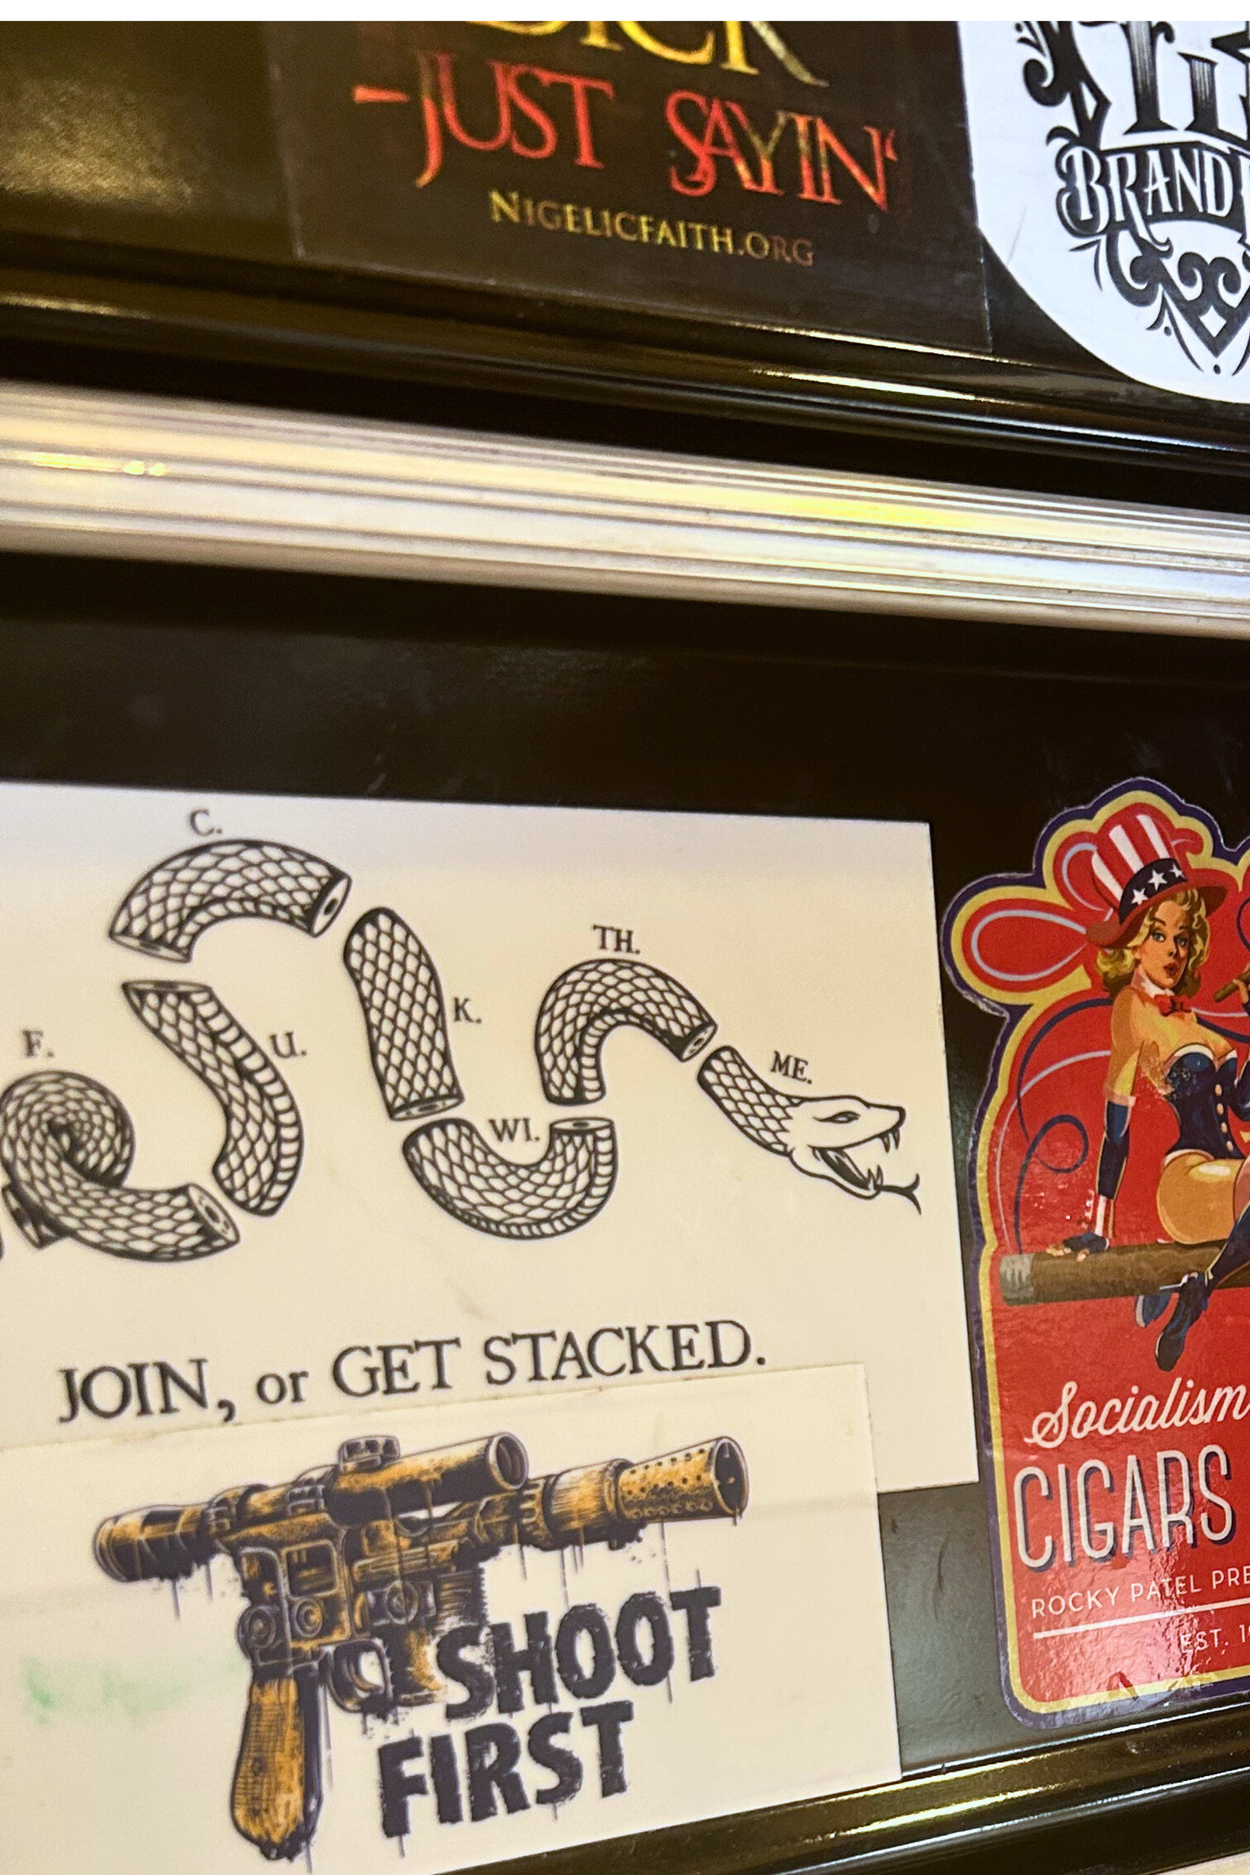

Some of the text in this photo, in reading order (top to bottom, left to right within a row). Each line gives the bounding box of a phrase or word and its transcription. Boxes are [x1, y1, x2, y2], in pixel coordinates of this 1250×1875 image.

[187, 808, 223, 838] C.
[592, 924, 640, 956] TH.
[452, 997, 482, 1025] K.
[22, 1030, 55, 1059] F.
[269, 1031, 308, 1059] U.
[771, 1051, 813, 1084] ME.
[488, 1117, 541, 1145] WI.
[58, 1319, 766, 1424] JOIN, or GET STACKED.
[1013, 1444, 1234, 1569] CIGARS
[1032, 1587, 1120, 1618] ROCKY
[1131, 1575, 1202, 1603] PATEL
[436, 1586, 722, 1720] SHOOT
[1180, 1626, 1230, 1653] EST.
[377, 1699, 635, 1839] FIRST
